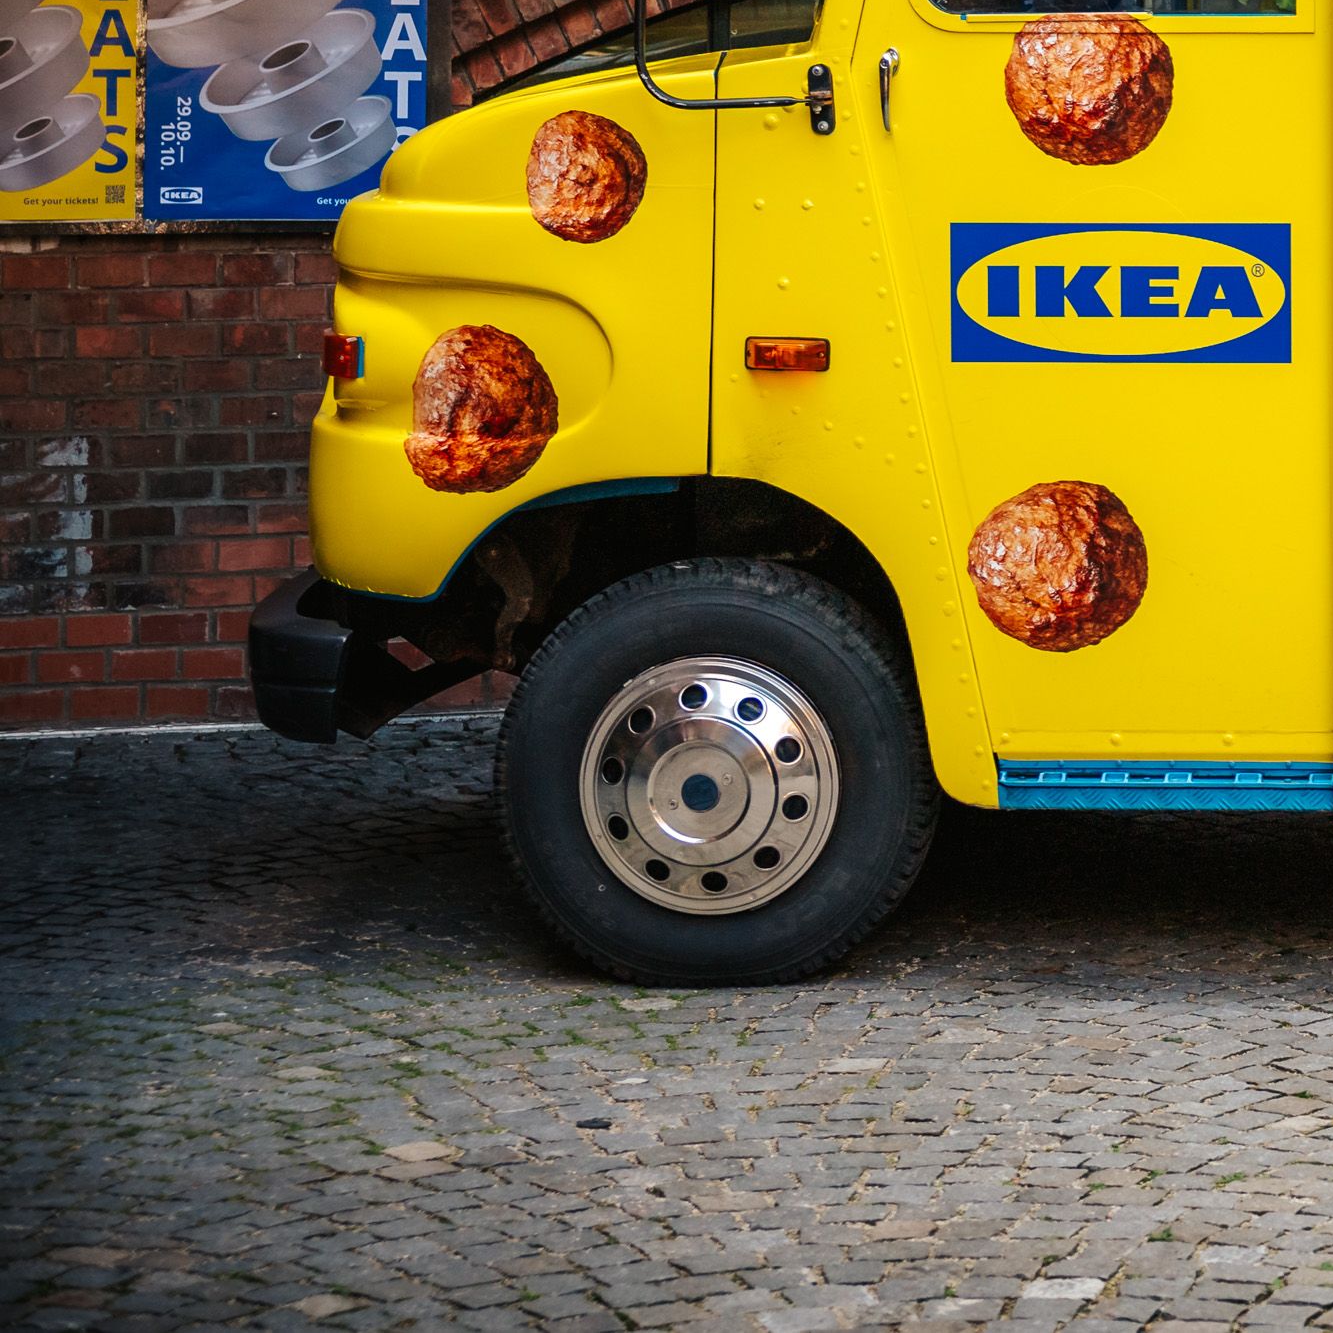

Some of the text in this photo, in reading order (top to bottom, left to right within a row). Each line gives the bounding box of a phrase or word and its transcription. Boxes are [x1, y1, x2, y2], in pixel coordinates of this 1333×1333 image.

[160, 122, 176, 171] 10.10.
[164, 191, 199, 199] IKEA
[23, 197, 99, 206] Get your tickets!
[316, 197, 352, 207] Get you
